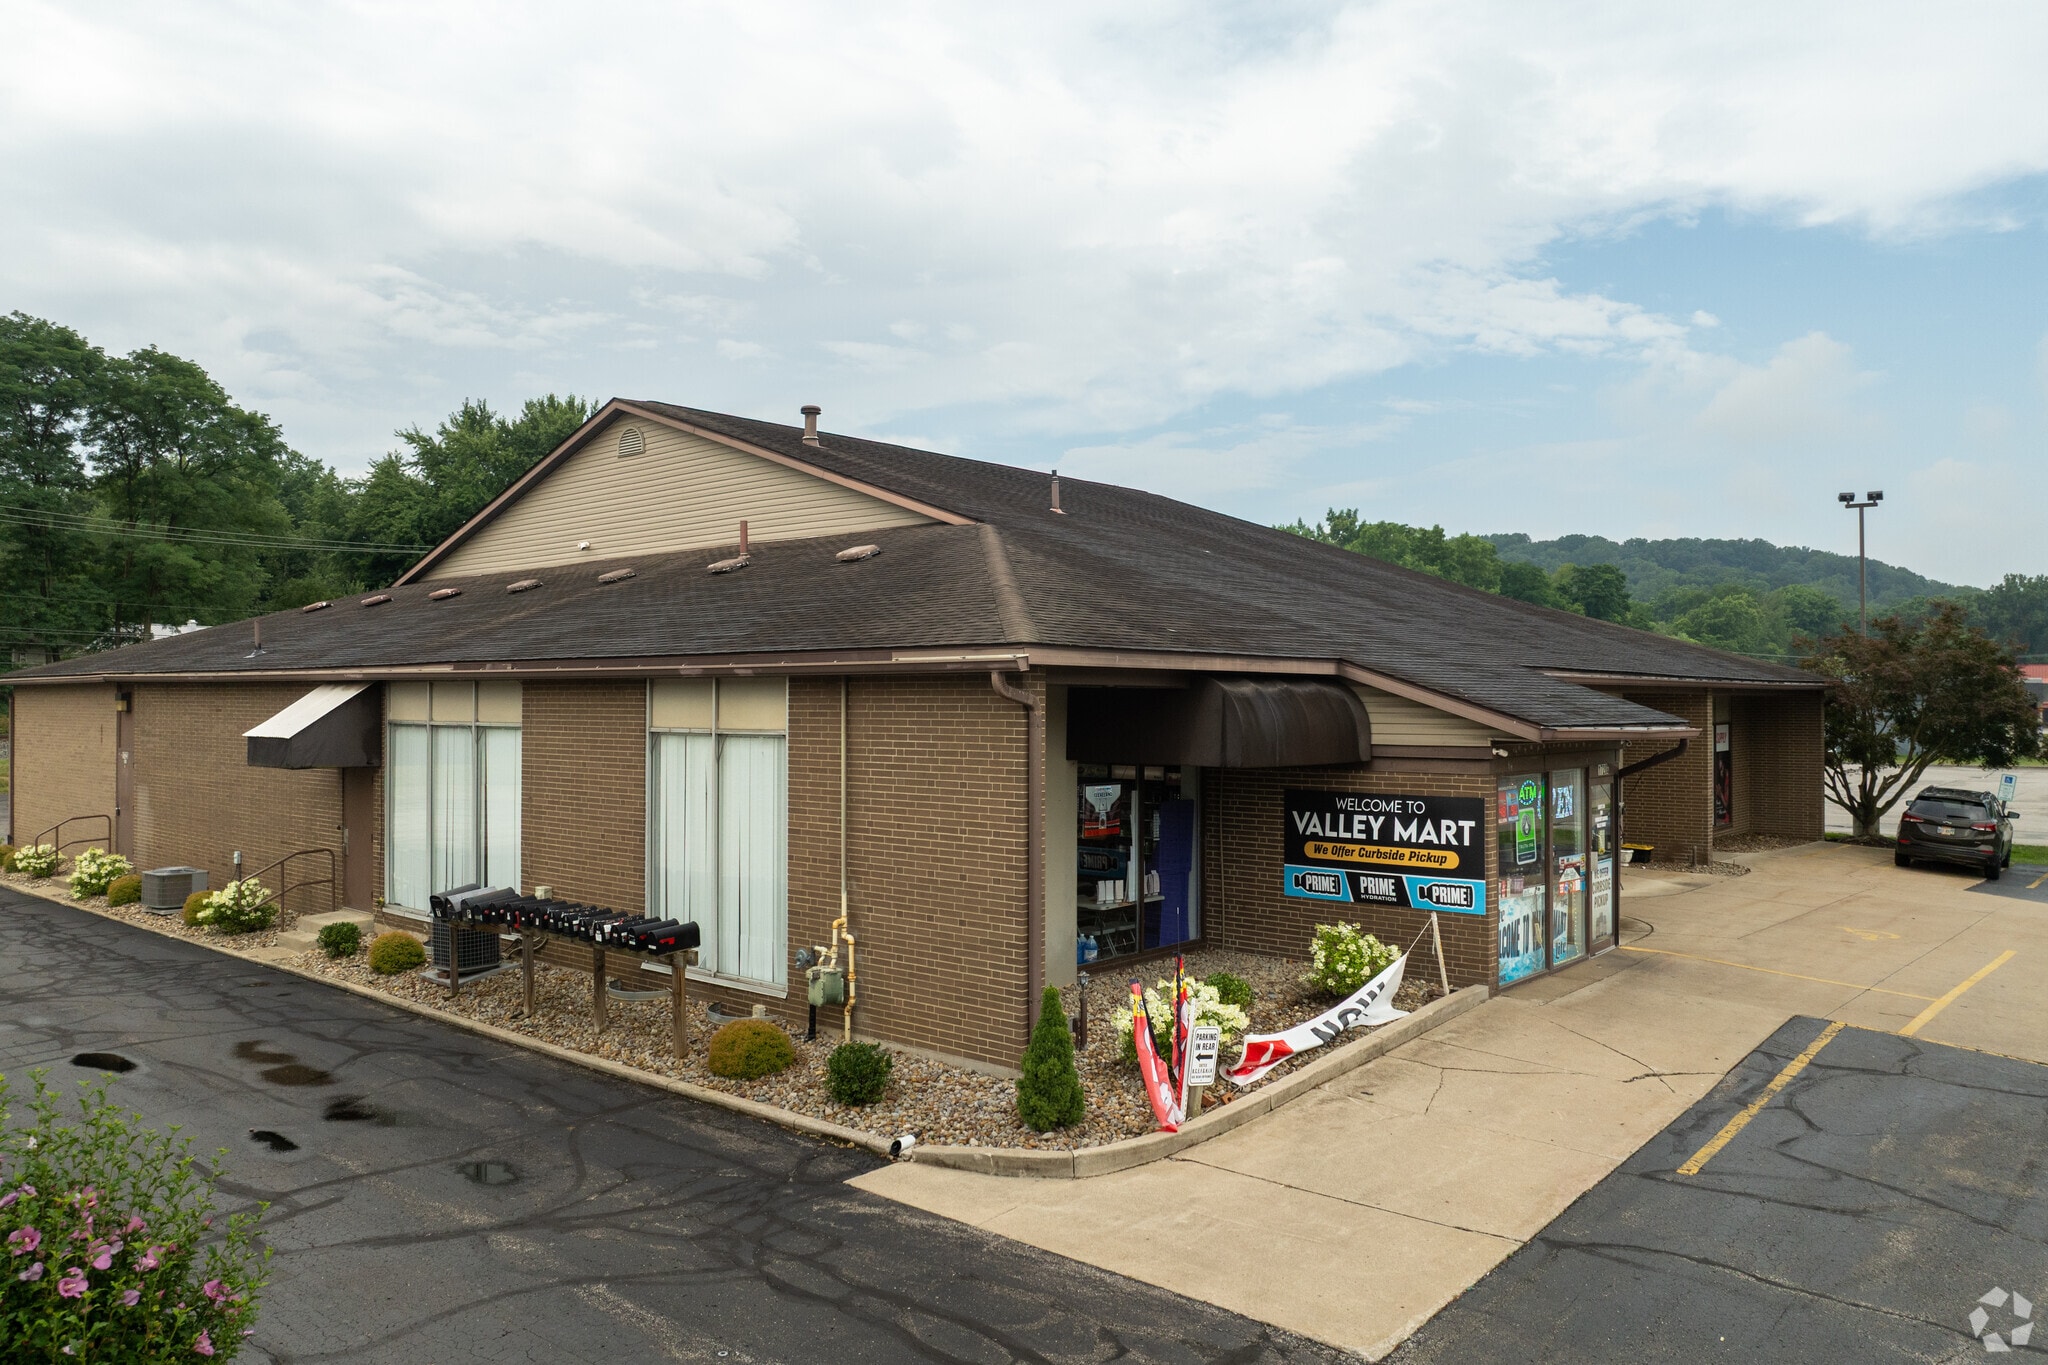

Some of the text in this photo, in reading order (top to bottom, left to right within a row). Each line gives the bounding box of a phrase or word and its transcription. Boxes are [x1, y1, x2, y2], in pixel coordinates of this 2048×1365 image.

[1518, 785, 1537, 801] ATM
[1336, 797, 1426, 815] WELCOME TO
[1292, 810, 1476, 846] VALLEY MART
[1313, 843, 1448, 866] We Offer Curbside Pickup
[1305, 874, 1336, 893] PRIME
[1360, 876, 1397, 896] PRIME
[1361, 894, 1397, 902] HYDRATION
[1432, 885, 1468, 906] PRIME
[1195, 1042, 1216, 1050] IN REAR
[1196, 1033, 1217, 1041] PARKING
